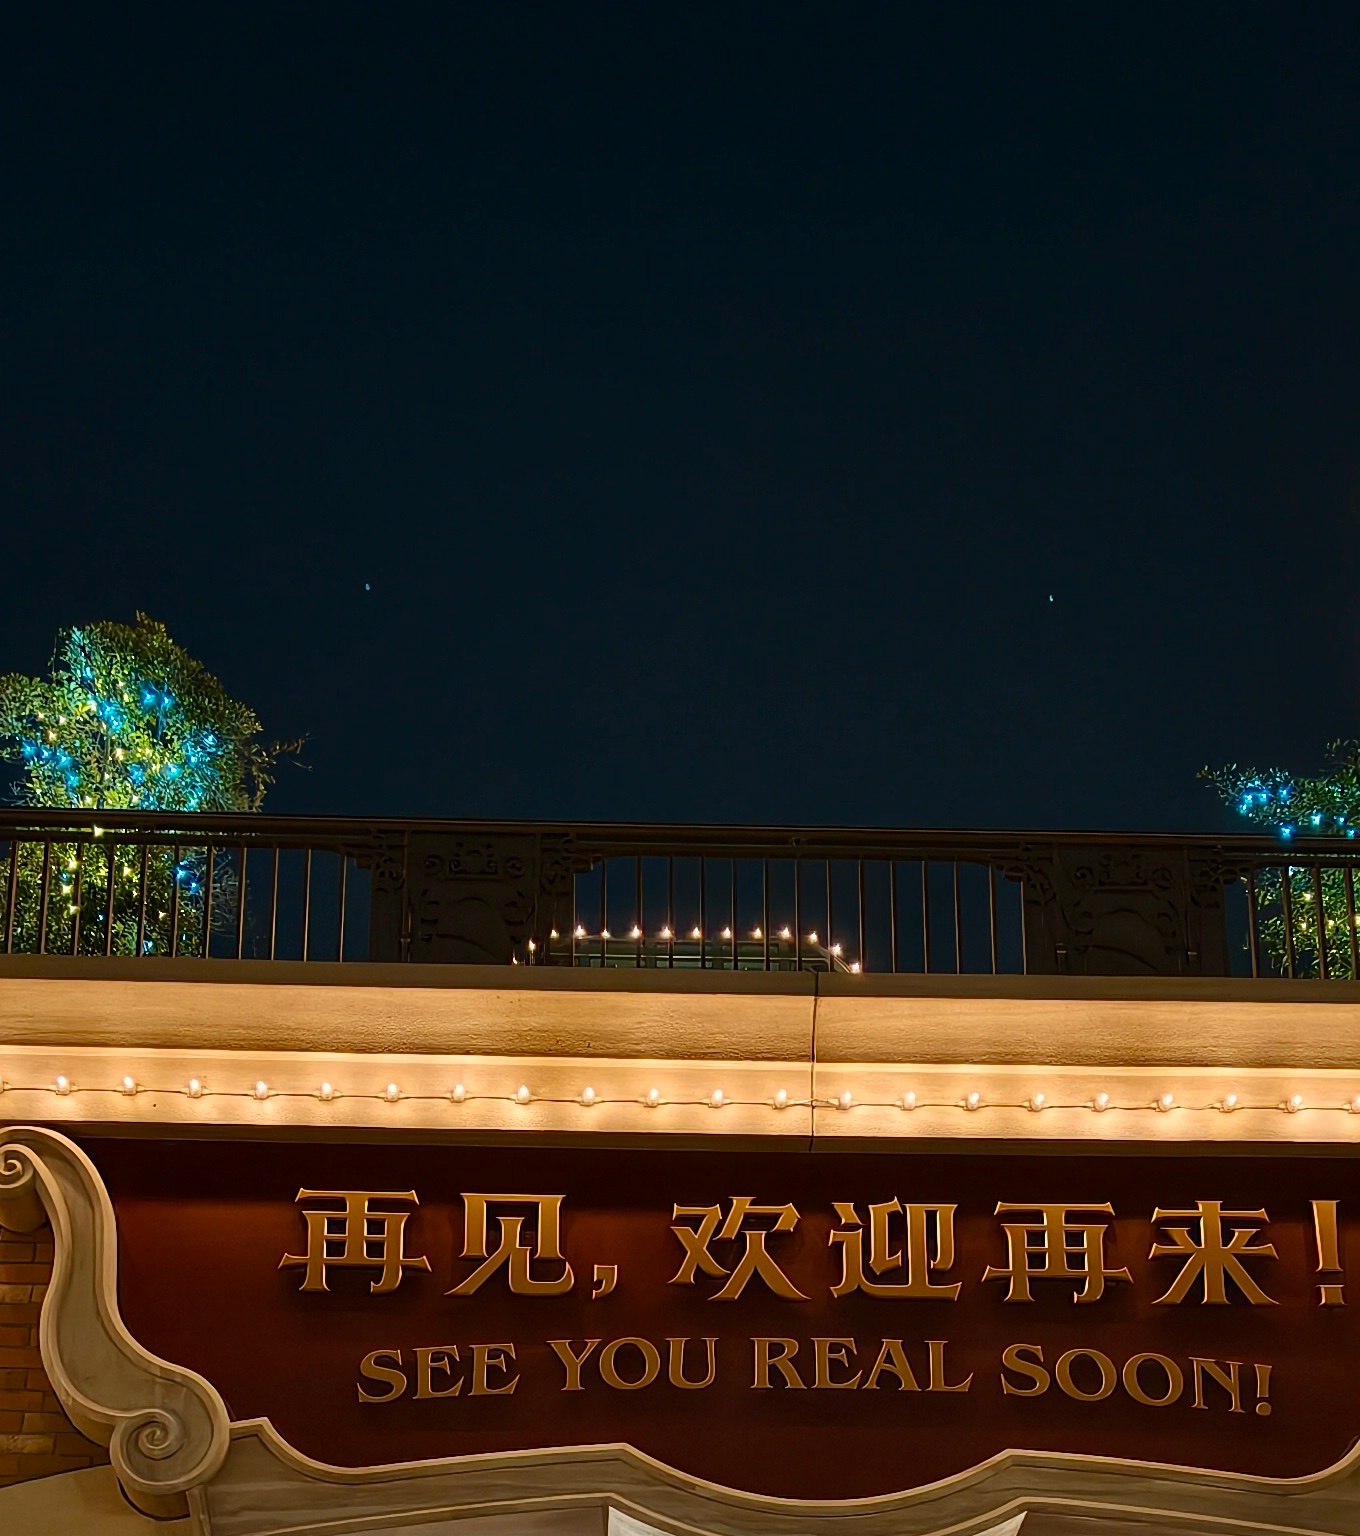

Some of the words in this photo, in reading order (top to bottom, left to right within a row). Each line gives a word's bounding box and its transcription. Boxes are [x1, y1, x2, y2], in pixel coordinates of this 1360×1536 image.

[277, 1187, 1346, 1306] 再见，欢迎再来！
[357, 1342, 521, 1403] SEE
[546, 1336, 720, 1391] YOU
[750, 1337, 974, 1392] REAL
[1000, 1343, 1273, 1417] SOON!
